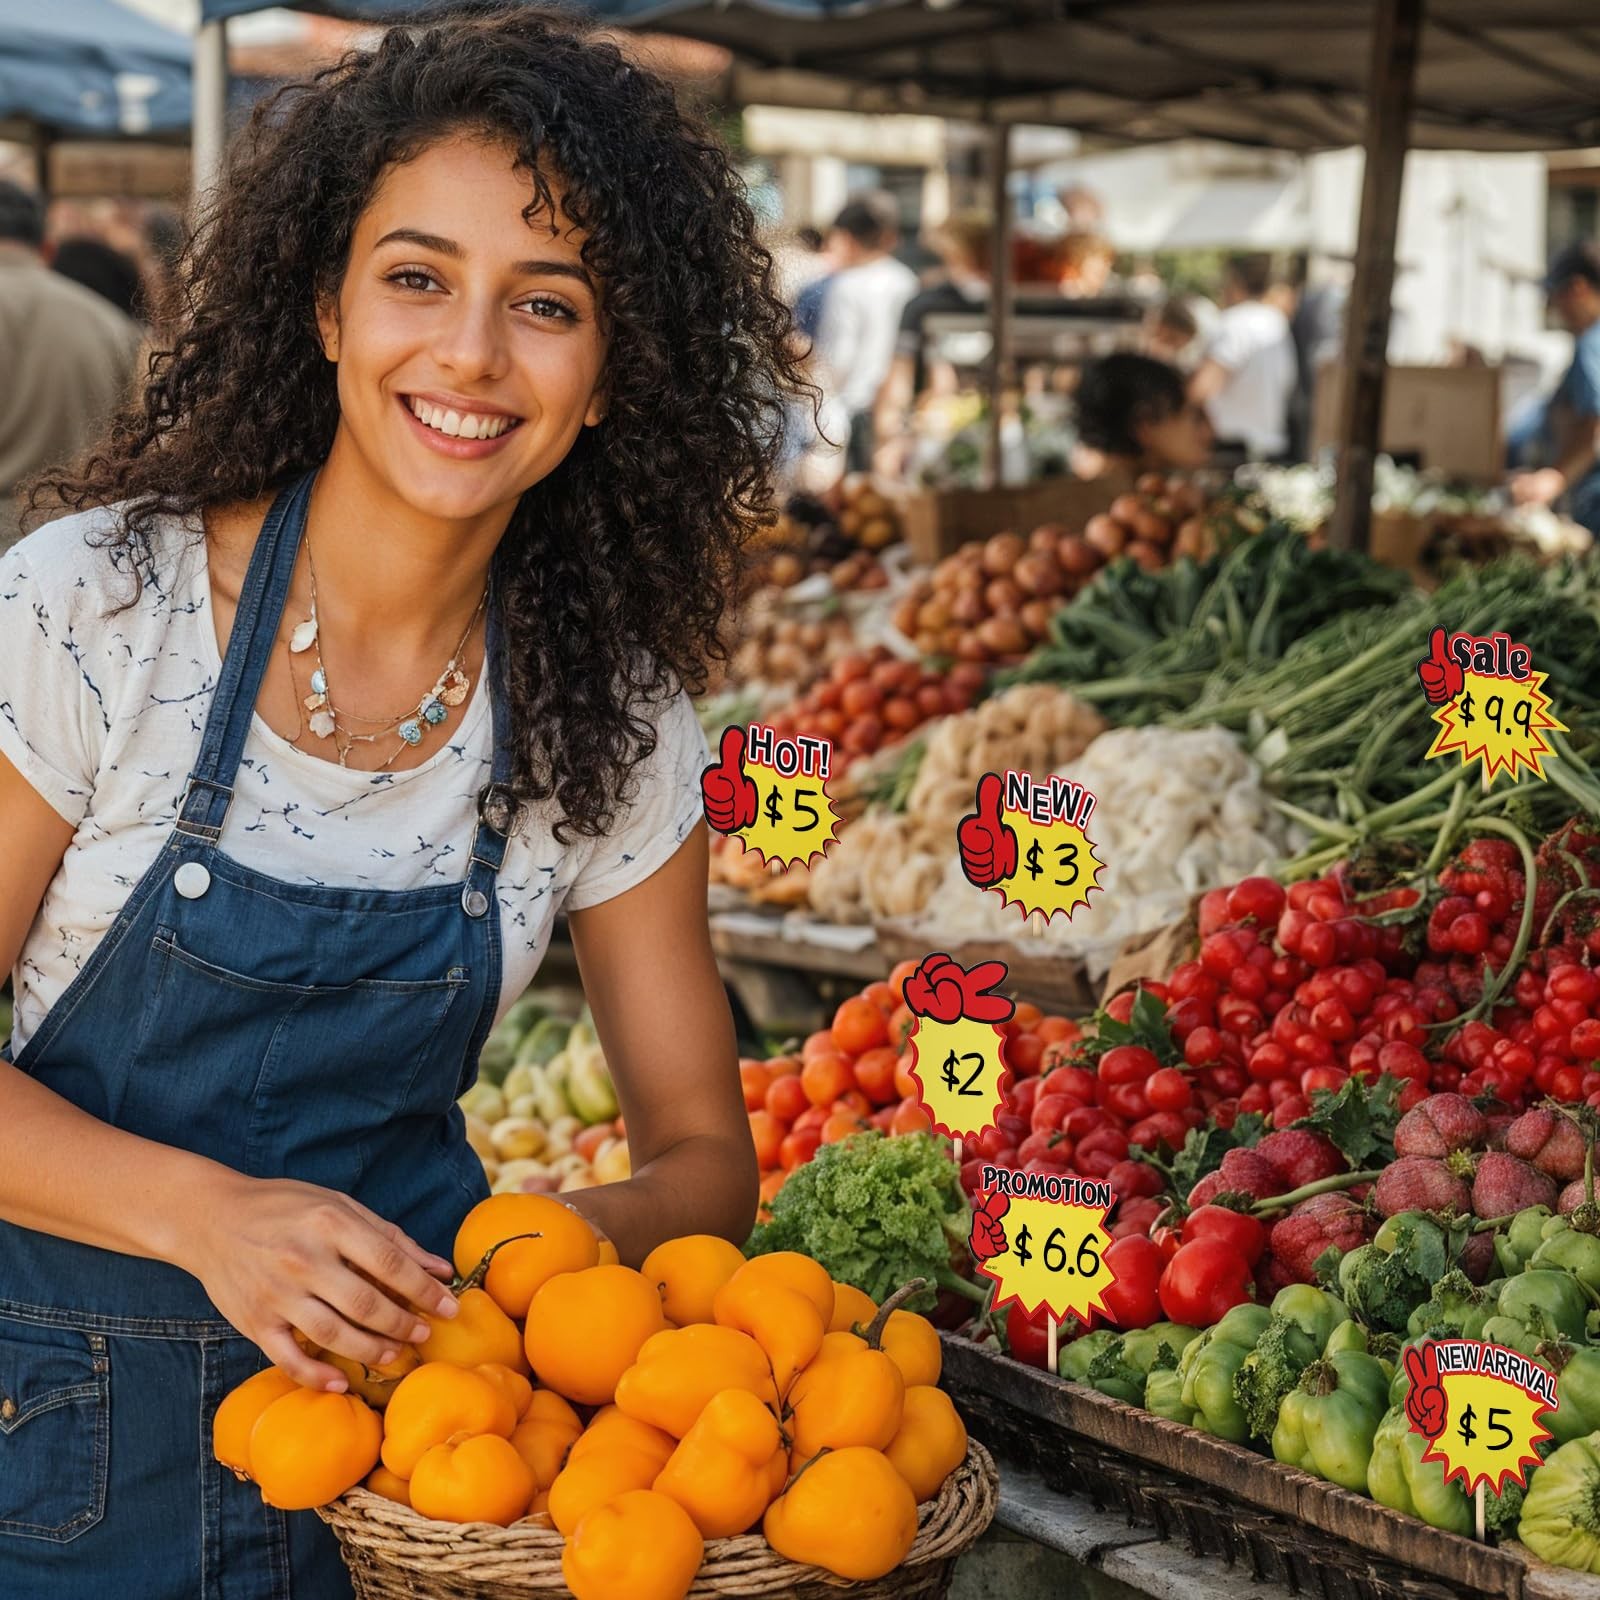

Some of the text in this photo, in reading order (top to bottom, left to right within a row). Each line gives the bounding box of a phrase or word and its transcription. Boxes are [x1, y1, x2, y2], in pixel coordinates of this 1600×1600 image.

[749, 725, 829, 777] HOT!
[1007, 772, 1095, 829] NEW!
[941, 1049, 984, 1096] $2
[983, 1166, 1111, 1207] PROMOTION
[1436, 1344, 1558, 1408] NEW ARRIVAL
